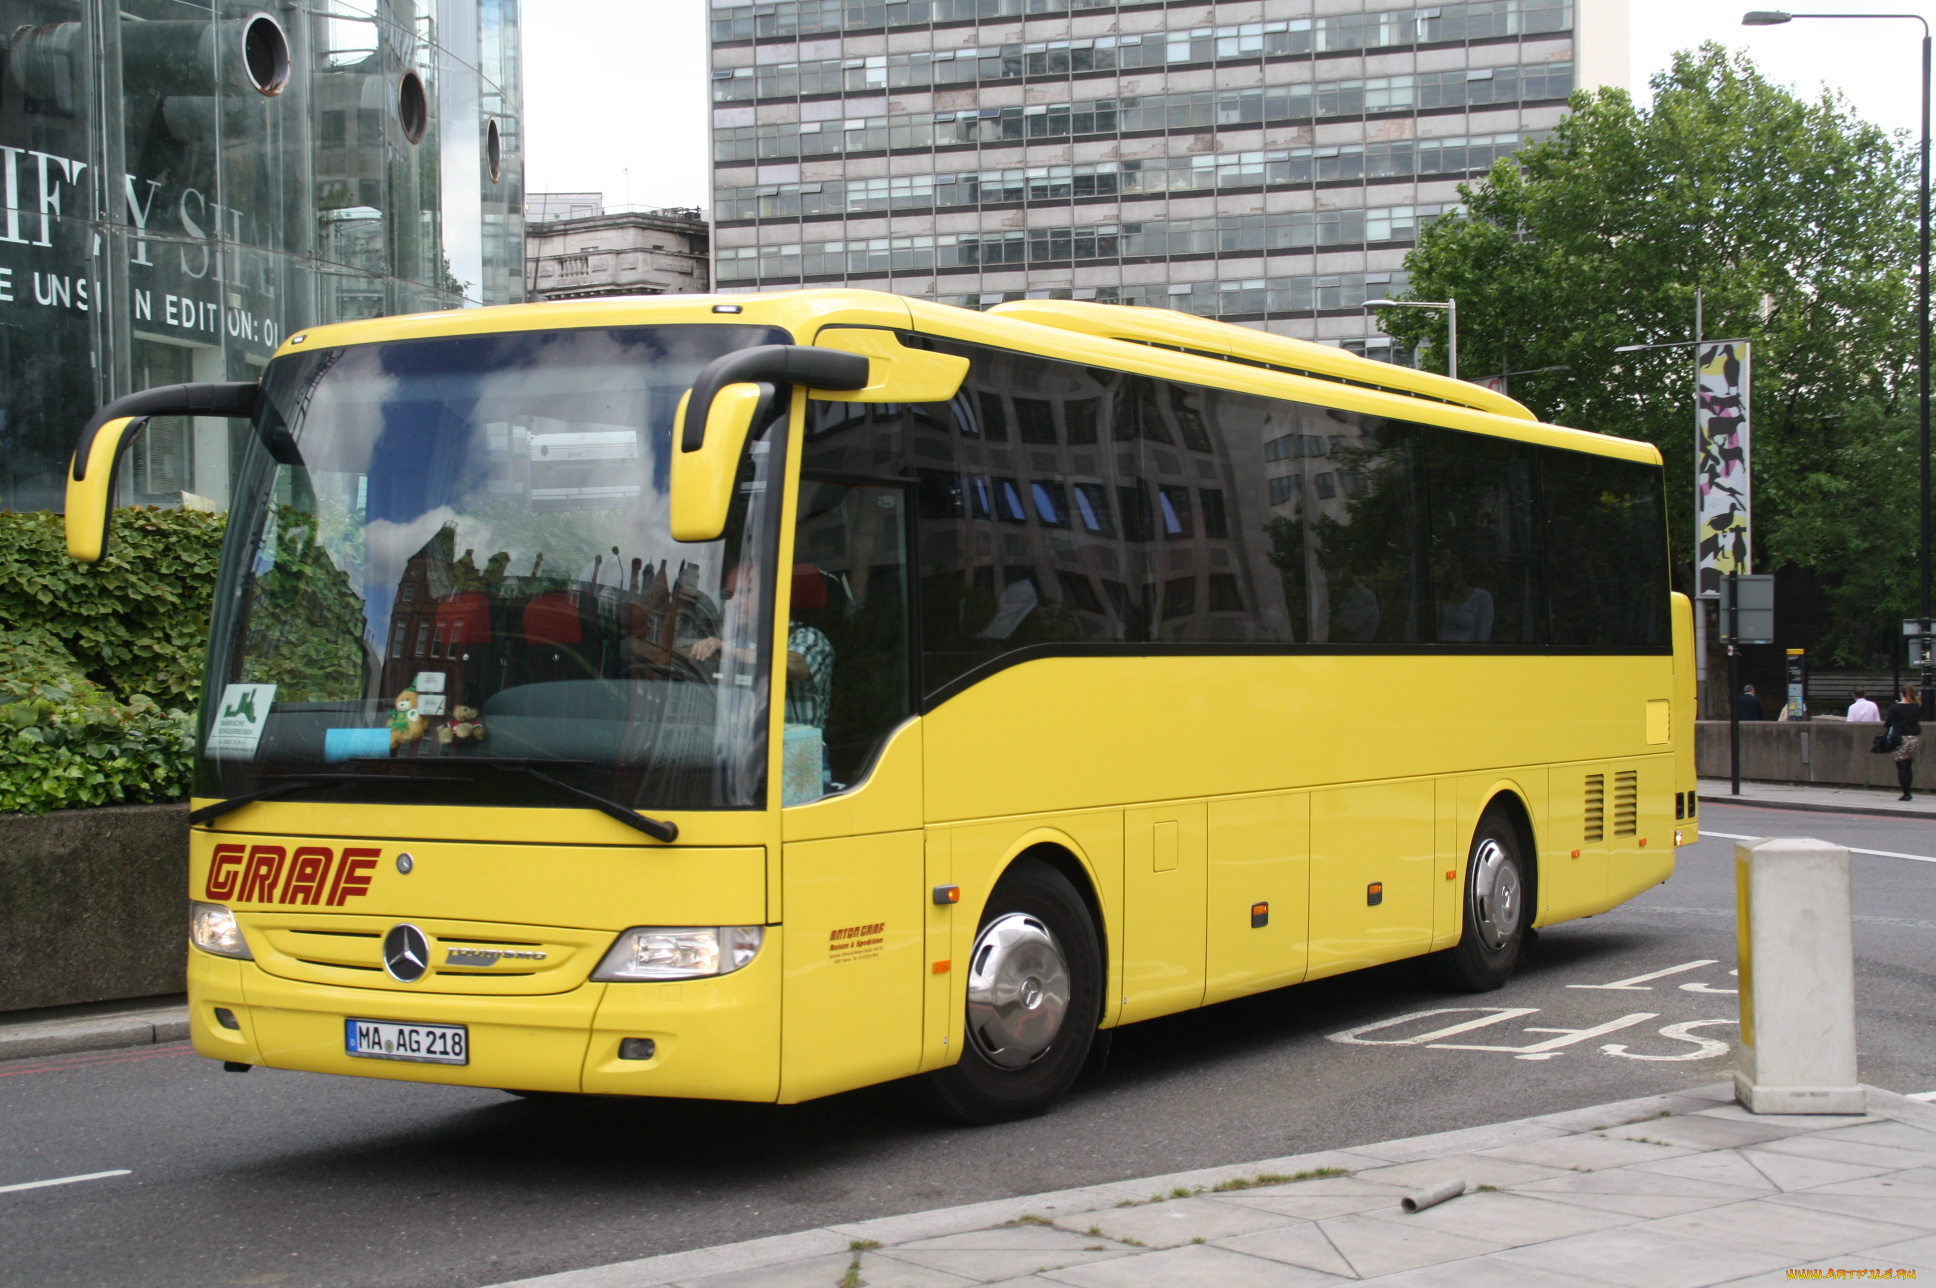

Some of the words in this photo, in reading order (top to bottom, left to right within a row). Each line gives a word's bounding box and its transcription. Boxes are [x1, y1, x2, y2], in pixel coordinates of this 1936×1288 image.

[34, 272, 152, 320] UNSN
[205, 843, 382, 907] GRAF
[829, 942, 849, 952] Reisen
[850, 941, 855, 949] &
[856, 937, 884, 949] Spedition
[830, 926, 861, 942] ANTON
[860, 922, 886, 936] GRAF
[446, 947, 548, 961] TOURISMO
[358, 1025, 383, 1050] MA
[396, 1028, 421, 1053] AG
[425, 1030, 463, 1057] 218
